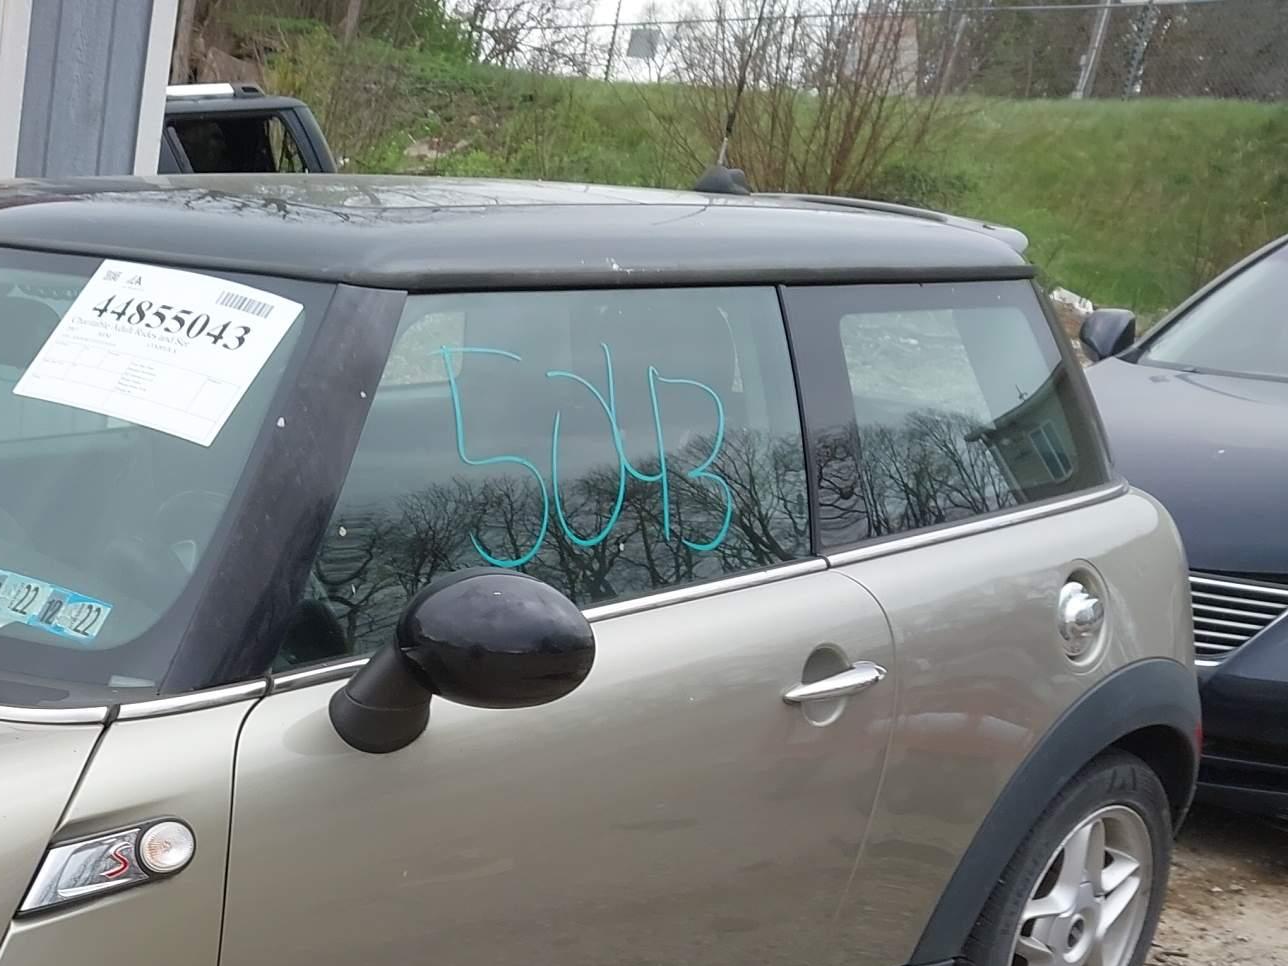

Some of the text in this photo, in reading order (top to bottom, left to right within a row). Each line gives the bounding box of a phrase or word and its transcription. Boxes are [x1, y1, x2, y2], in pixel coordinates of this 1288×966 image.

[92, 294, 252, 351] 44855043
[432, 342, 733, 568] 5043
[11, 583, 40, 616] 22
[39, 598, 102, 637] 12 22
[99, 841, 132, 879] S
